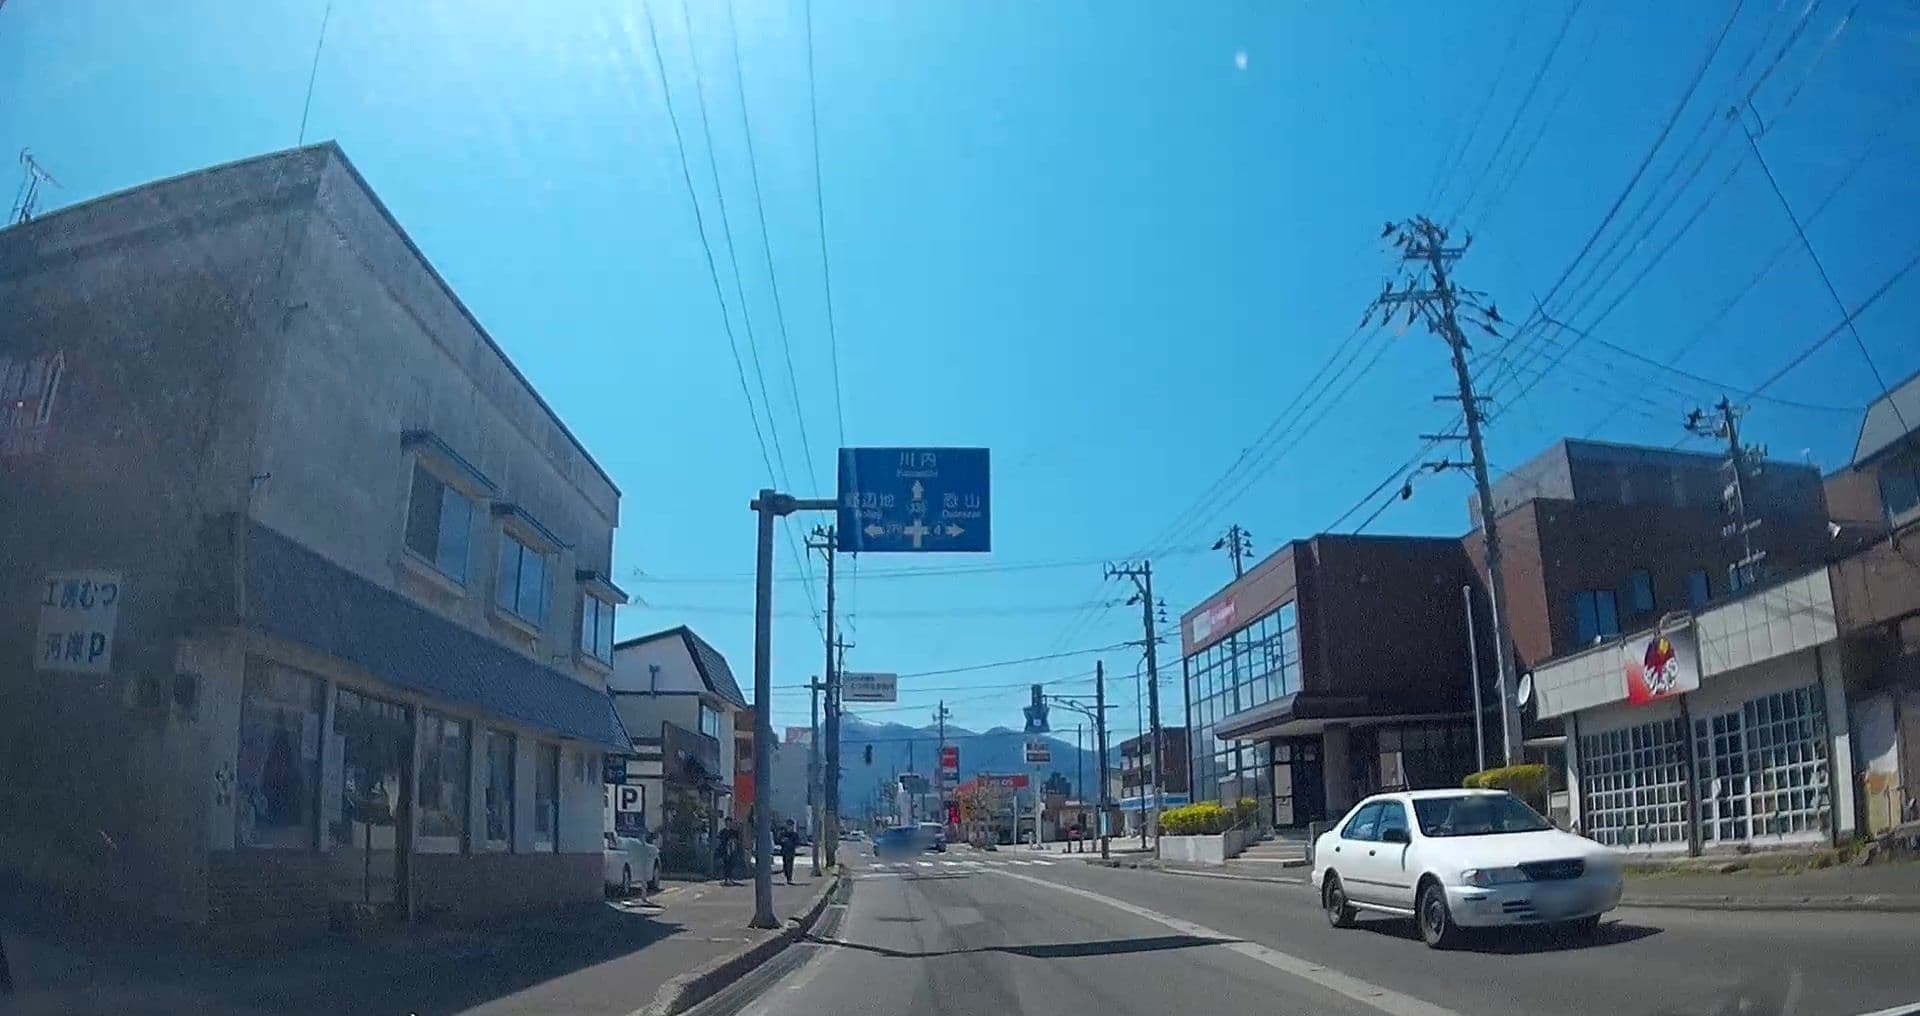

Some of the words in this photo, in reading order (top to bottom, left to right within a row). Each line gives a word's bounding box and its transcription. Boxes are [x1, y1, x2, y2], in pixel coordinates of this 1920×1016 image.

[899, 452, 936, 467] 川内
[943, 492, 980, 508] 恐山
[622, 787, 638, 810] P
